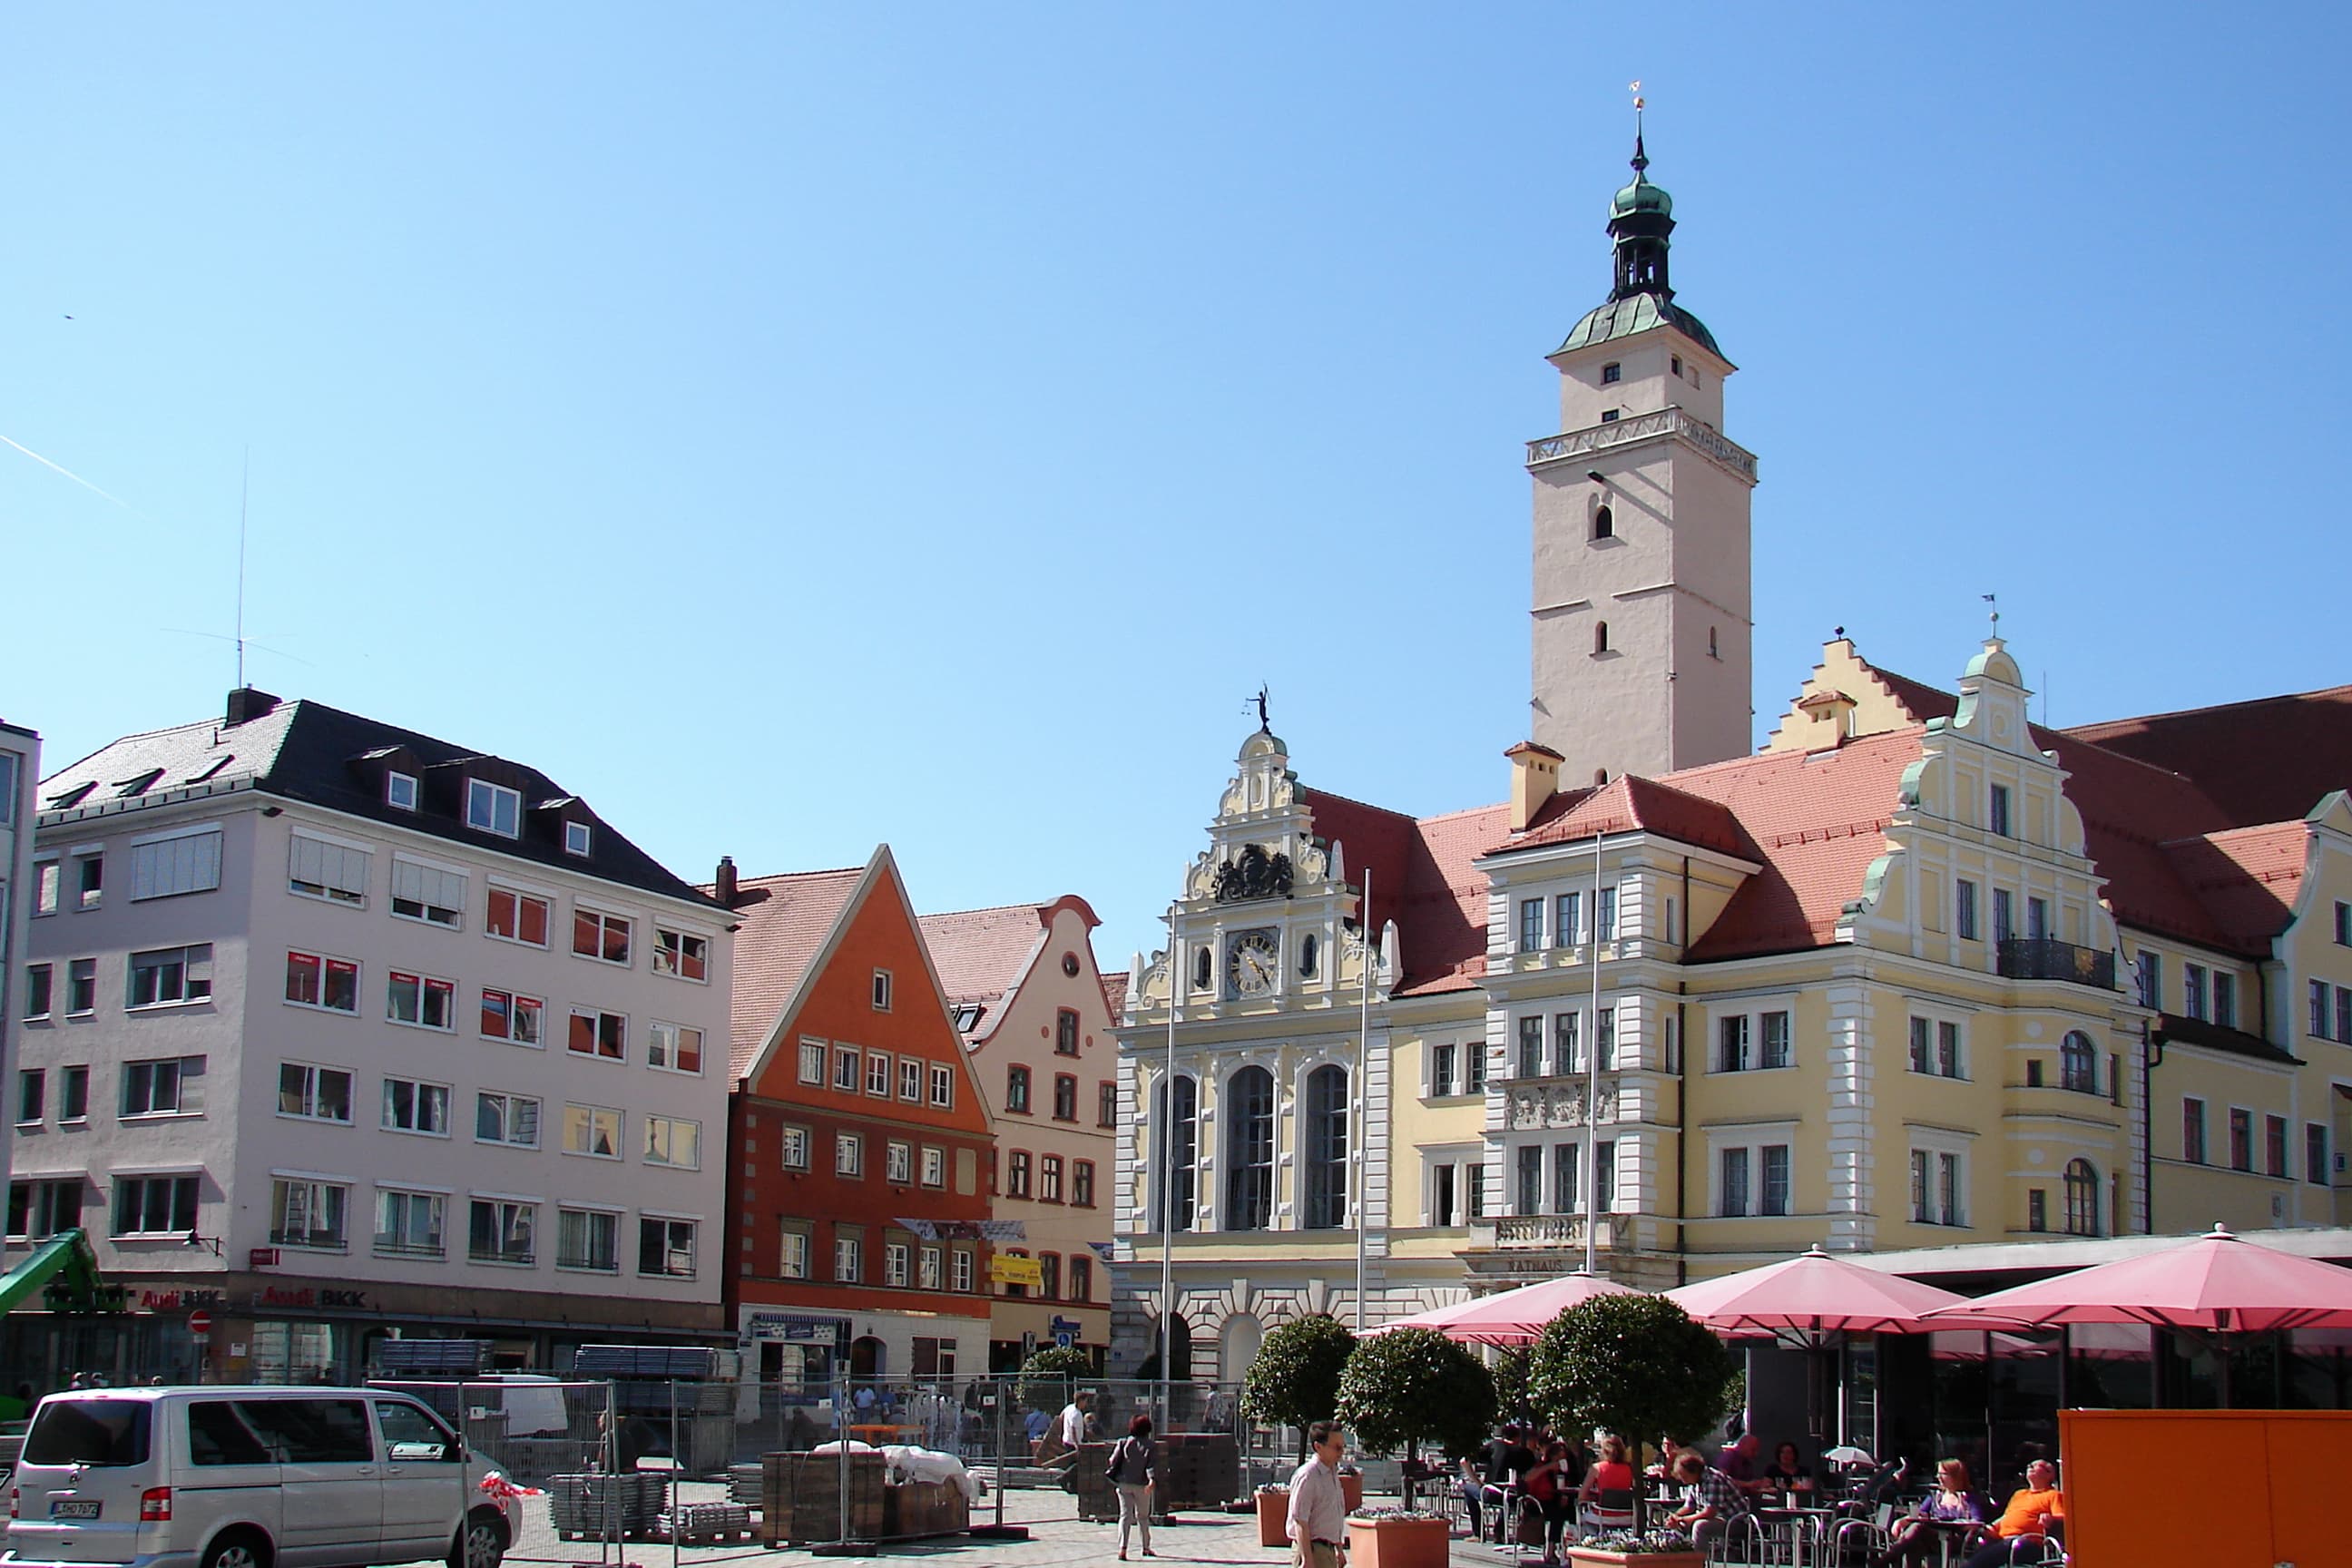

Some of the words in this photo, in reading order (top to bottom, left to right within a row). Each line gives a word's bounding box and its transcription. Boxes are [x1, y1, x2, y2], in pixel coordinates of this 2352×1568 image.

[1509, 1259, 1563, 1271] RATHAUS
[141, 1289, 180, 1308] Audi
[262, 1285, 315, 1307] Audi
[322, 1289, 367, 1308] BKK
